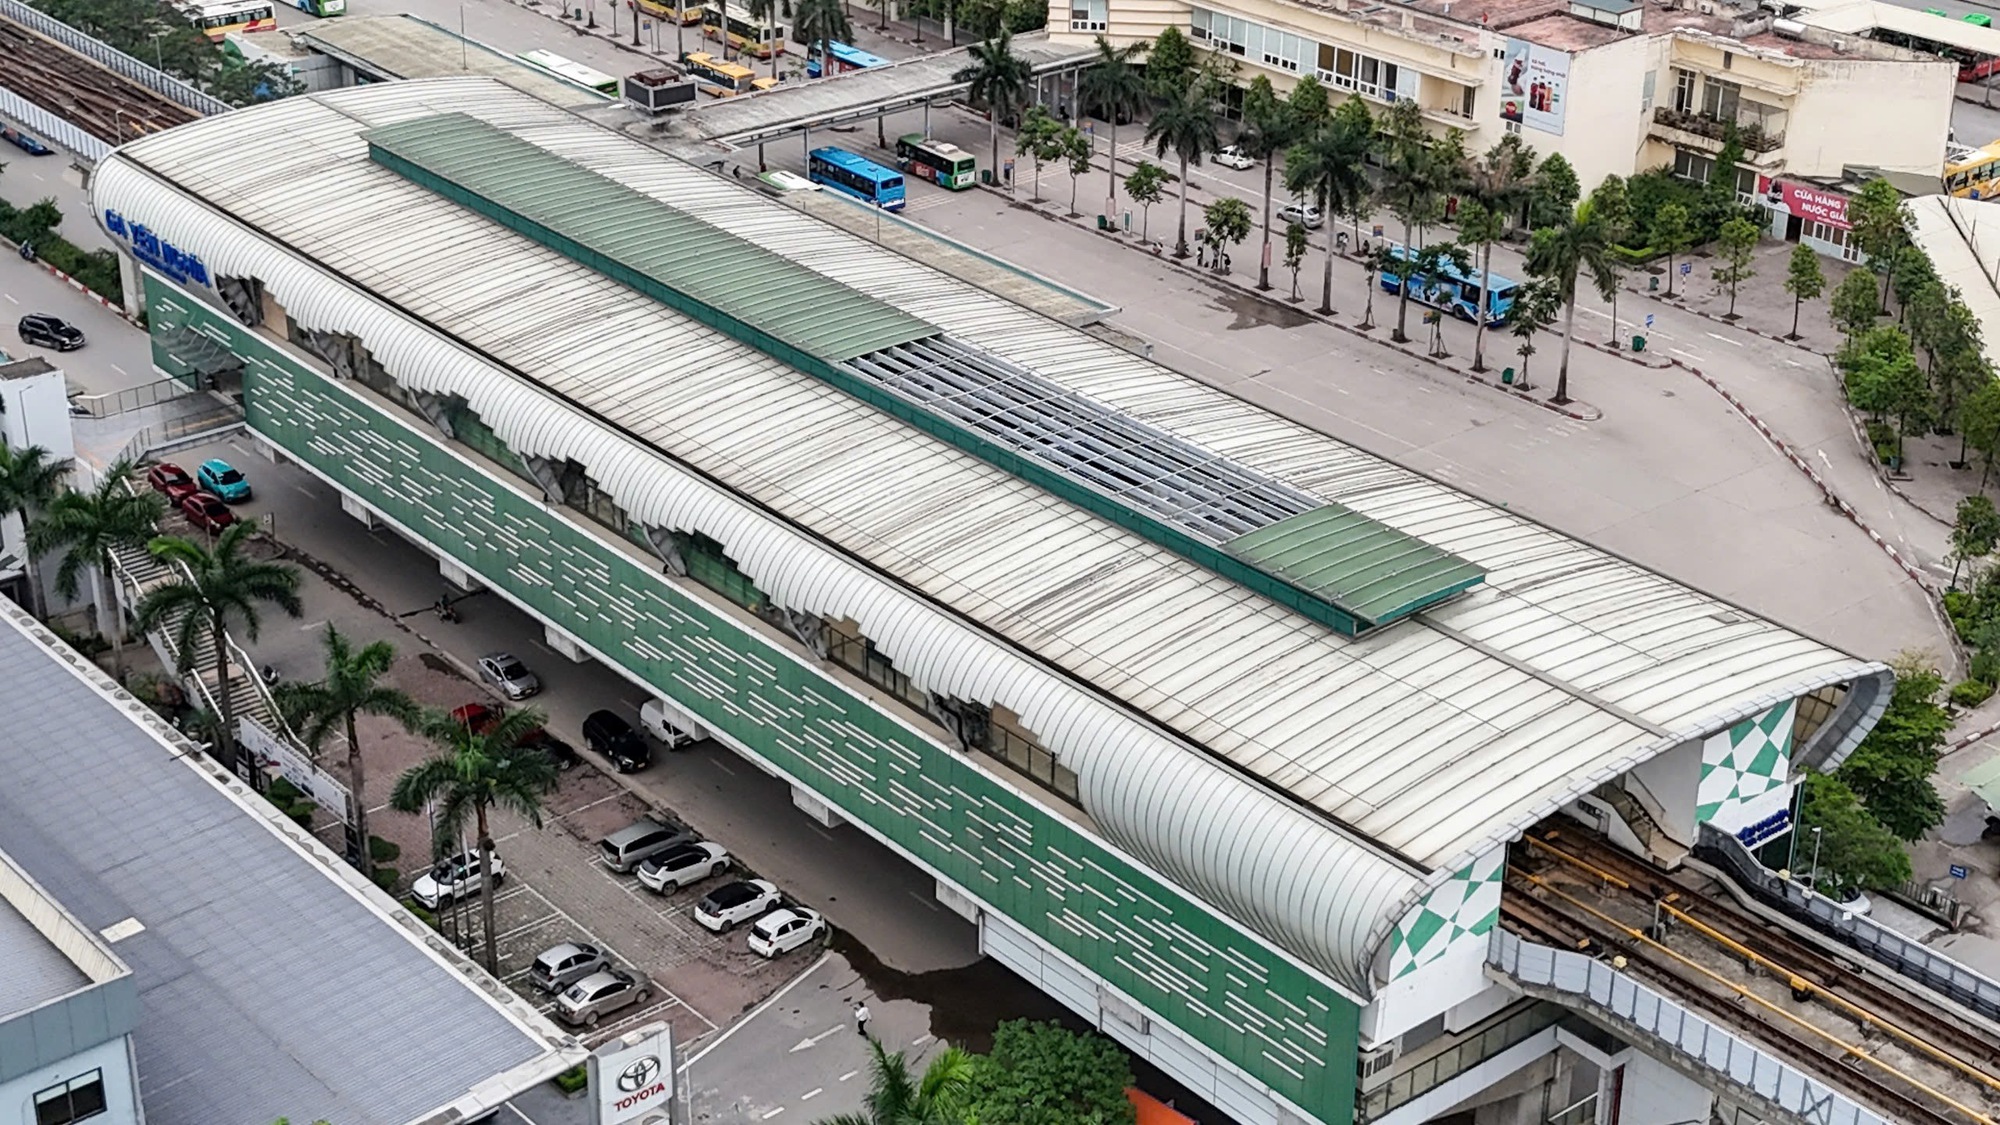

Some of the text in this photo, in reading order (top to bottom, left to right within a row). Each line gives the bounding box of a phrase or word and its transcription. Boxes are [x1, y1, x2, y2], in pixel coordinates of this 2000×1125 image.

[1802, 202, 1828, 216] NƯỚC
[1815, 194, 1841, 210] HÀNG
[613, 1082, 665, 1111] TOYOTA
